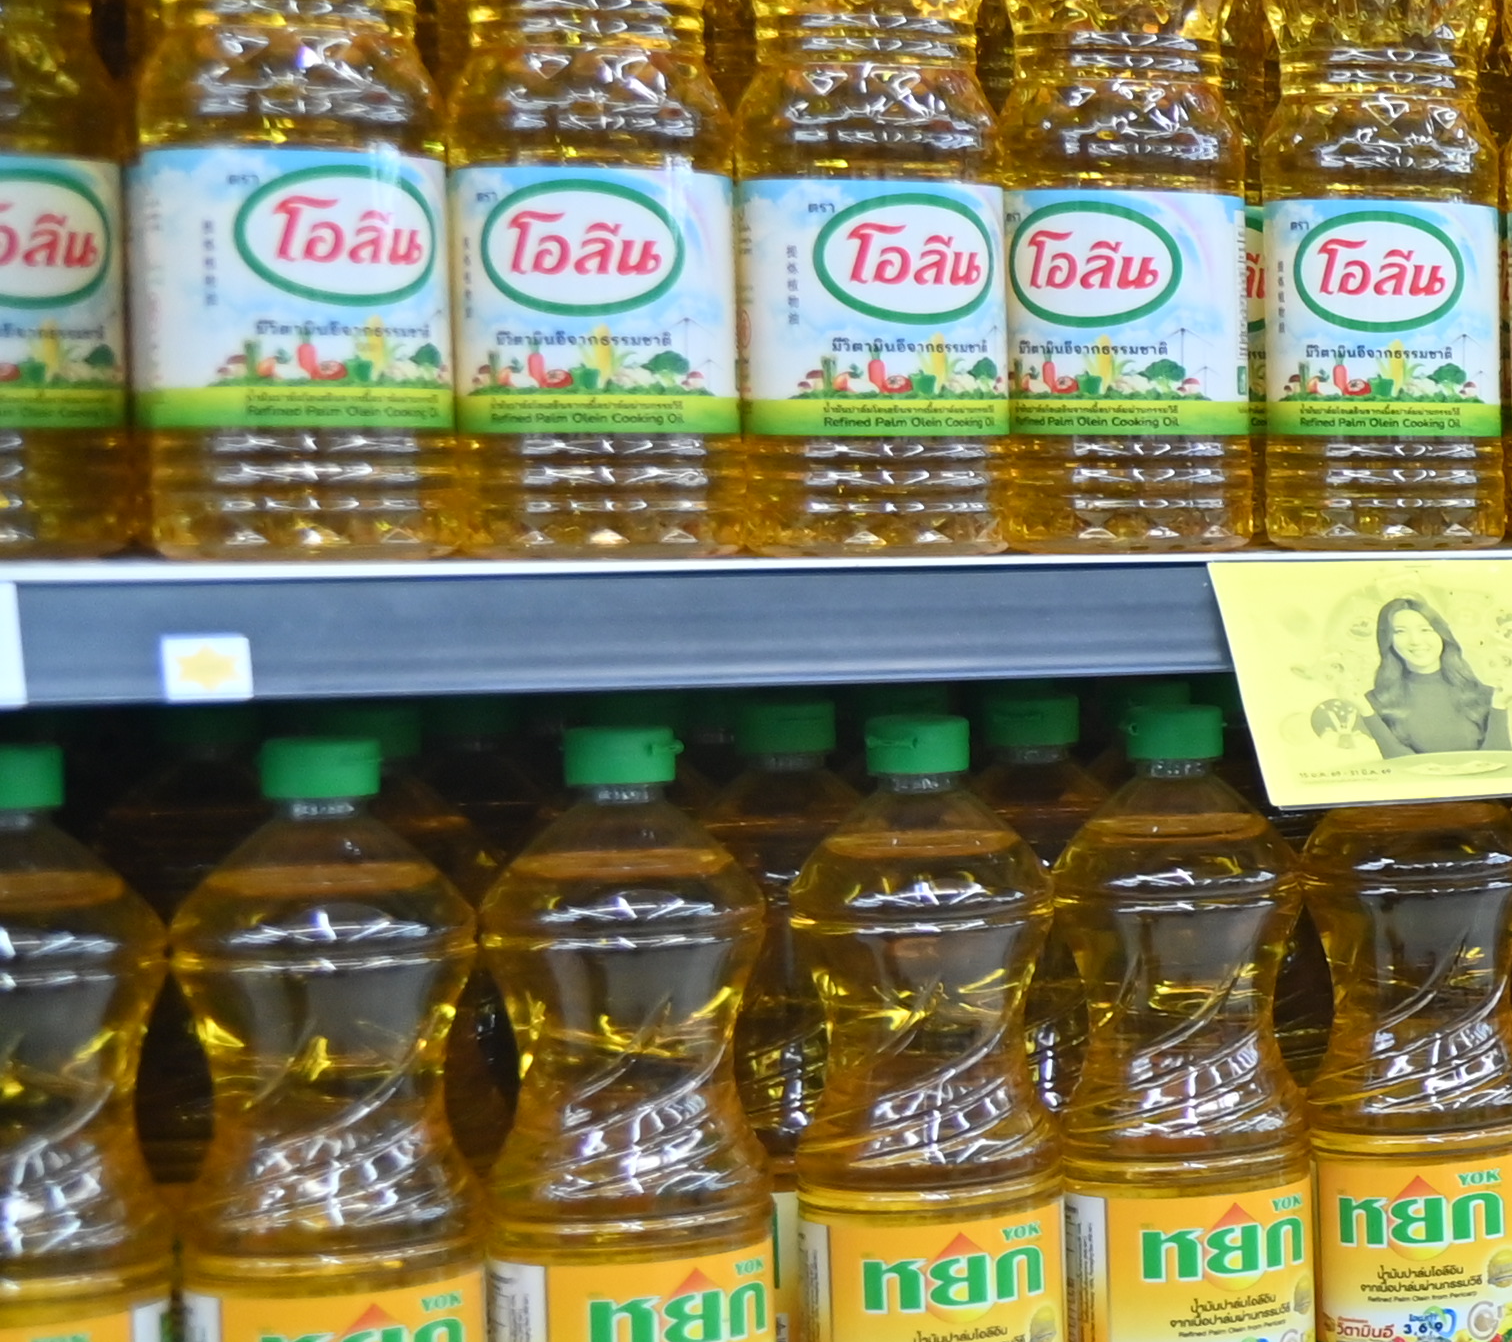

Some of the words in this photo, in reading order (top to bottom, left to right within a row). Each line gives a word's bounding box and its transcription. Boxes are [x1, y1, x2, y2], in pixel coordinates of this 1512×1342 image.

[808, 202, 835, 214] ตรา
[276, 196, 421, 264] โอลีน
[1290, 221, 1310, 232] ตรา
[510, 211, 660, 275] โอลีน
[849, 223, 980, 285] โอลีน
[1028, 230, 1158, 289] โอลีน
[1319, 239, 1445, 296] โอลีน
[832, 336, 988, 354] มีวิตามินอีจากธรรมชาติ
[1018, 340, 1169, 355] มีวิตามินอีจากธรรมชาติ
[1306, 344, 1454, 360] มีวิตามินอีจากธรรมชาติ
[824, 416, 871, 428] Refined
[875, 416, 907, 428] Palm
[911, 416, 942, 428] Olein
[945, 416, 983, 430] Cooking
[1048, 416, 1074, 427] Palm
[1077, 416, 1107, 428] Olein
[1112, 416, 1159, 429] Cooking
[1163, 416, 1180, 427] Oil
[1300, 417, 1336, 428] Refined
[1338, 417, 1366, 428] Palm
[1369, 417, 1400, 428] Olein
[1403, 417, 1445, 430] Cooking
[1448, 417, 1461, 428] Oil
[1457, 1168, 1502, 1188] YOK
[1341, 1194, 1500, 1244] หยก
[1002, 1221, 1042, 1242] YOK
[1143, 1219, 1301, 1278] หยก
[865, 1248, 1040, 1309] หยก
[1337, 1323, 1395, 1339] วิตามินอี
